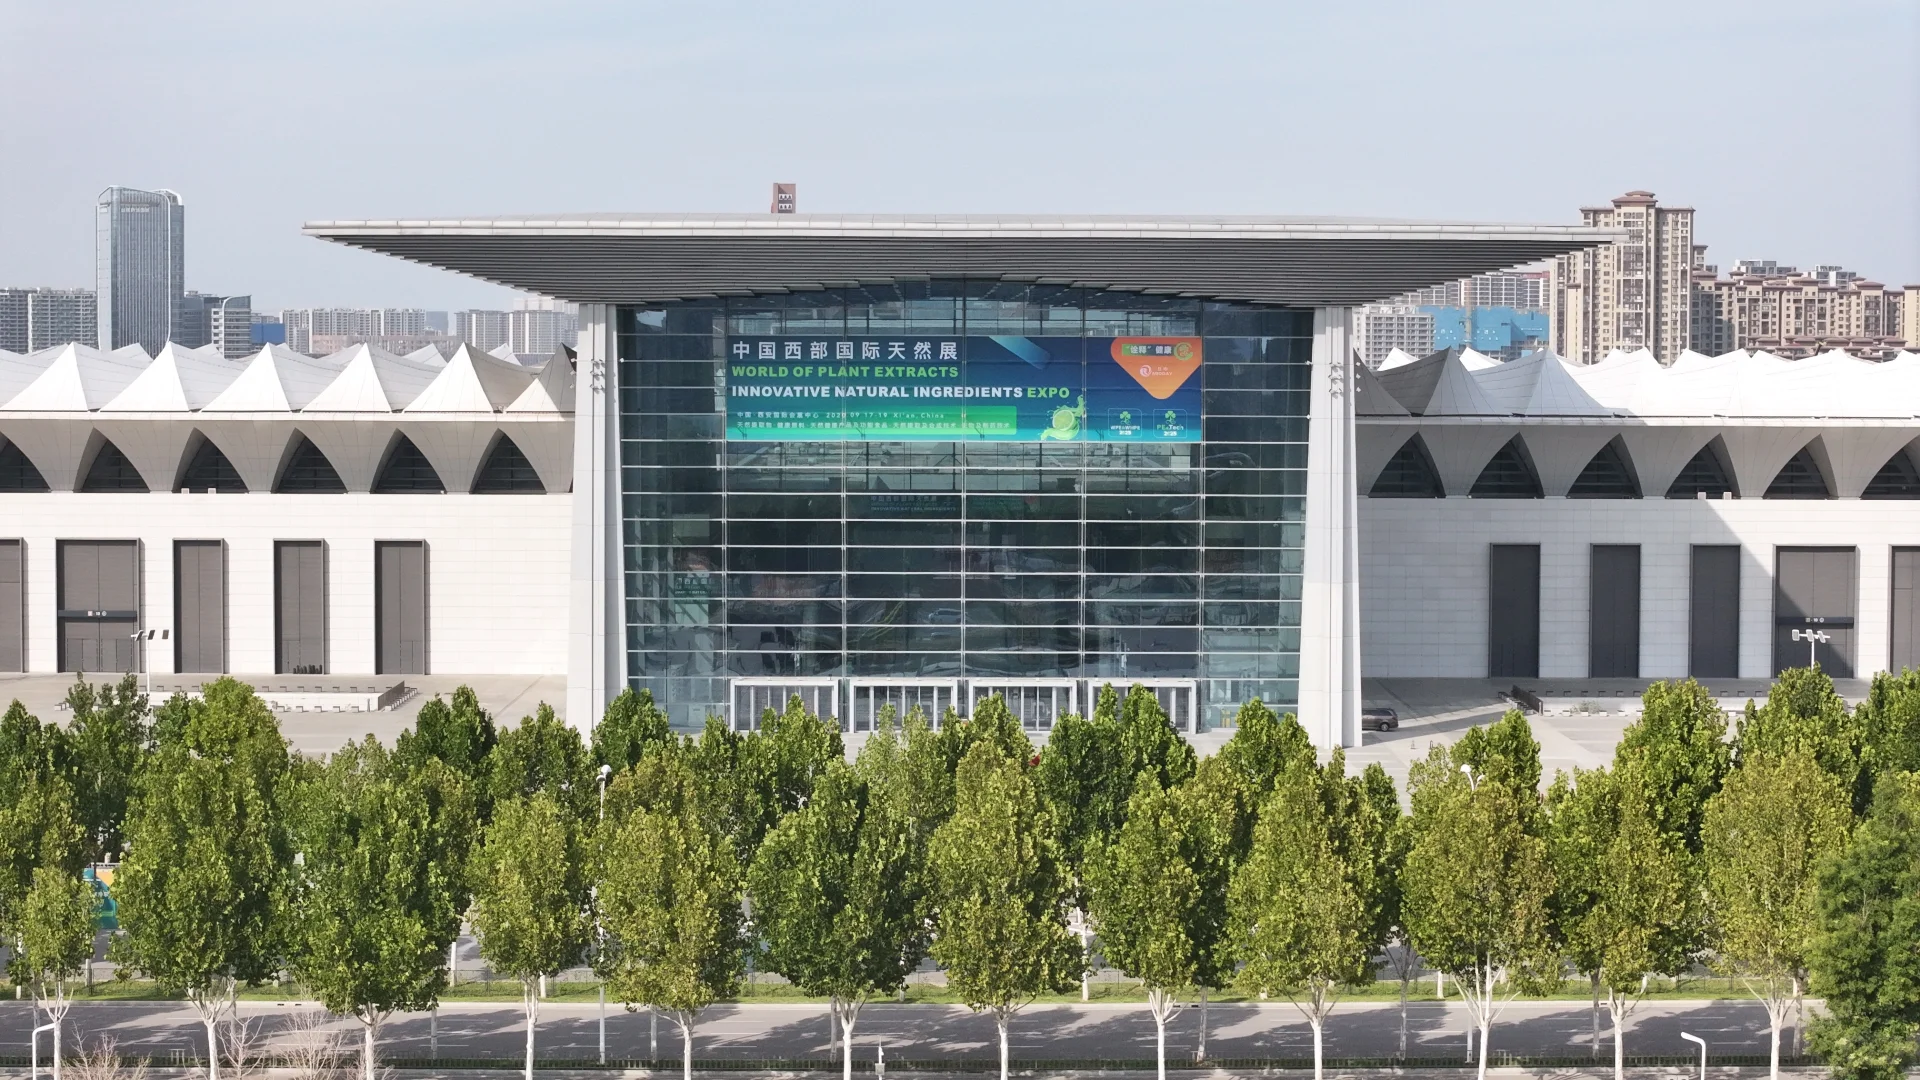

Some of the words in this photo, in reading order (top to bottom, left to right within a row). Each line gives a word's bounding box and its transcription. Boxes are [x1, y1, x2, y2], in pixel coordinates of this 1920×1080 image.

[732, 341, 958, 360] 中国西部国际天然展
[732, 366, 789, 377] WORLD
[793, 366, 813, 377] OF
[818, 366, 870, 378] PLANT
[874, 366, 959, 378] EXTRACTS
[732, 386, 830, 397] INNOVATIVE
[834, 386, 909, 397] NATURAL
[913, 387, 1023, 398] INGREDIENTS
[1027, 387, 1070, 398] EXPO
